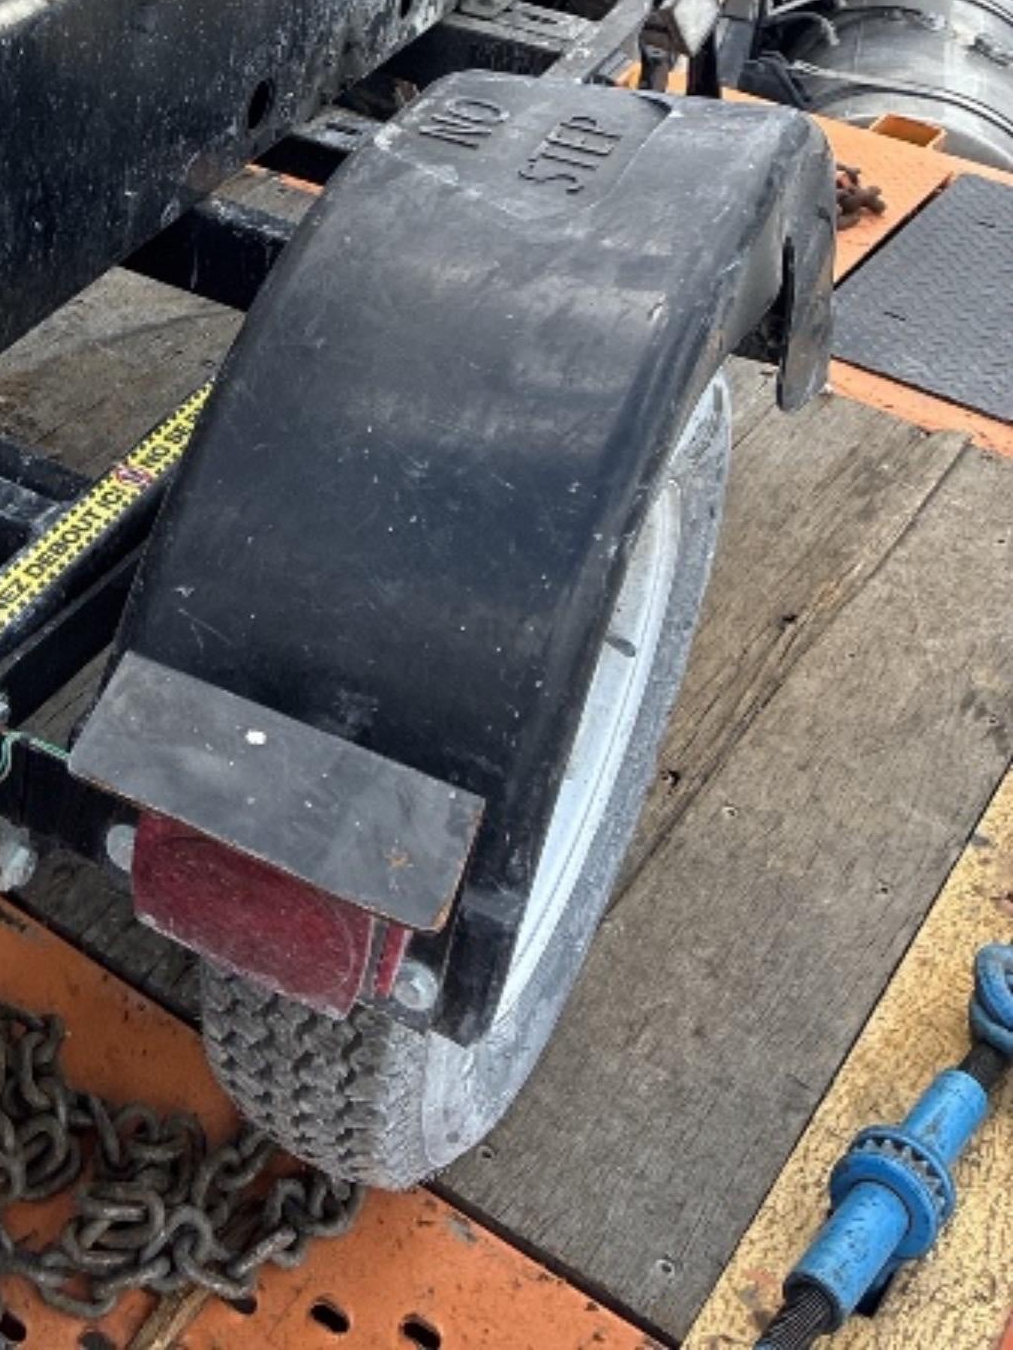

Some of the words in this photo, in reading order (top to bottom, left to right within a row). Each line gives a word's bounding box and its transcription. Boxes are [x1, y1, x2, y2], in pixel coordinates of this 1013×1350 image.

[419, 100, 508, 150] NO
[518, 116, 622, 195] STEP
[23, 507, 103, 579] DEBOUT
